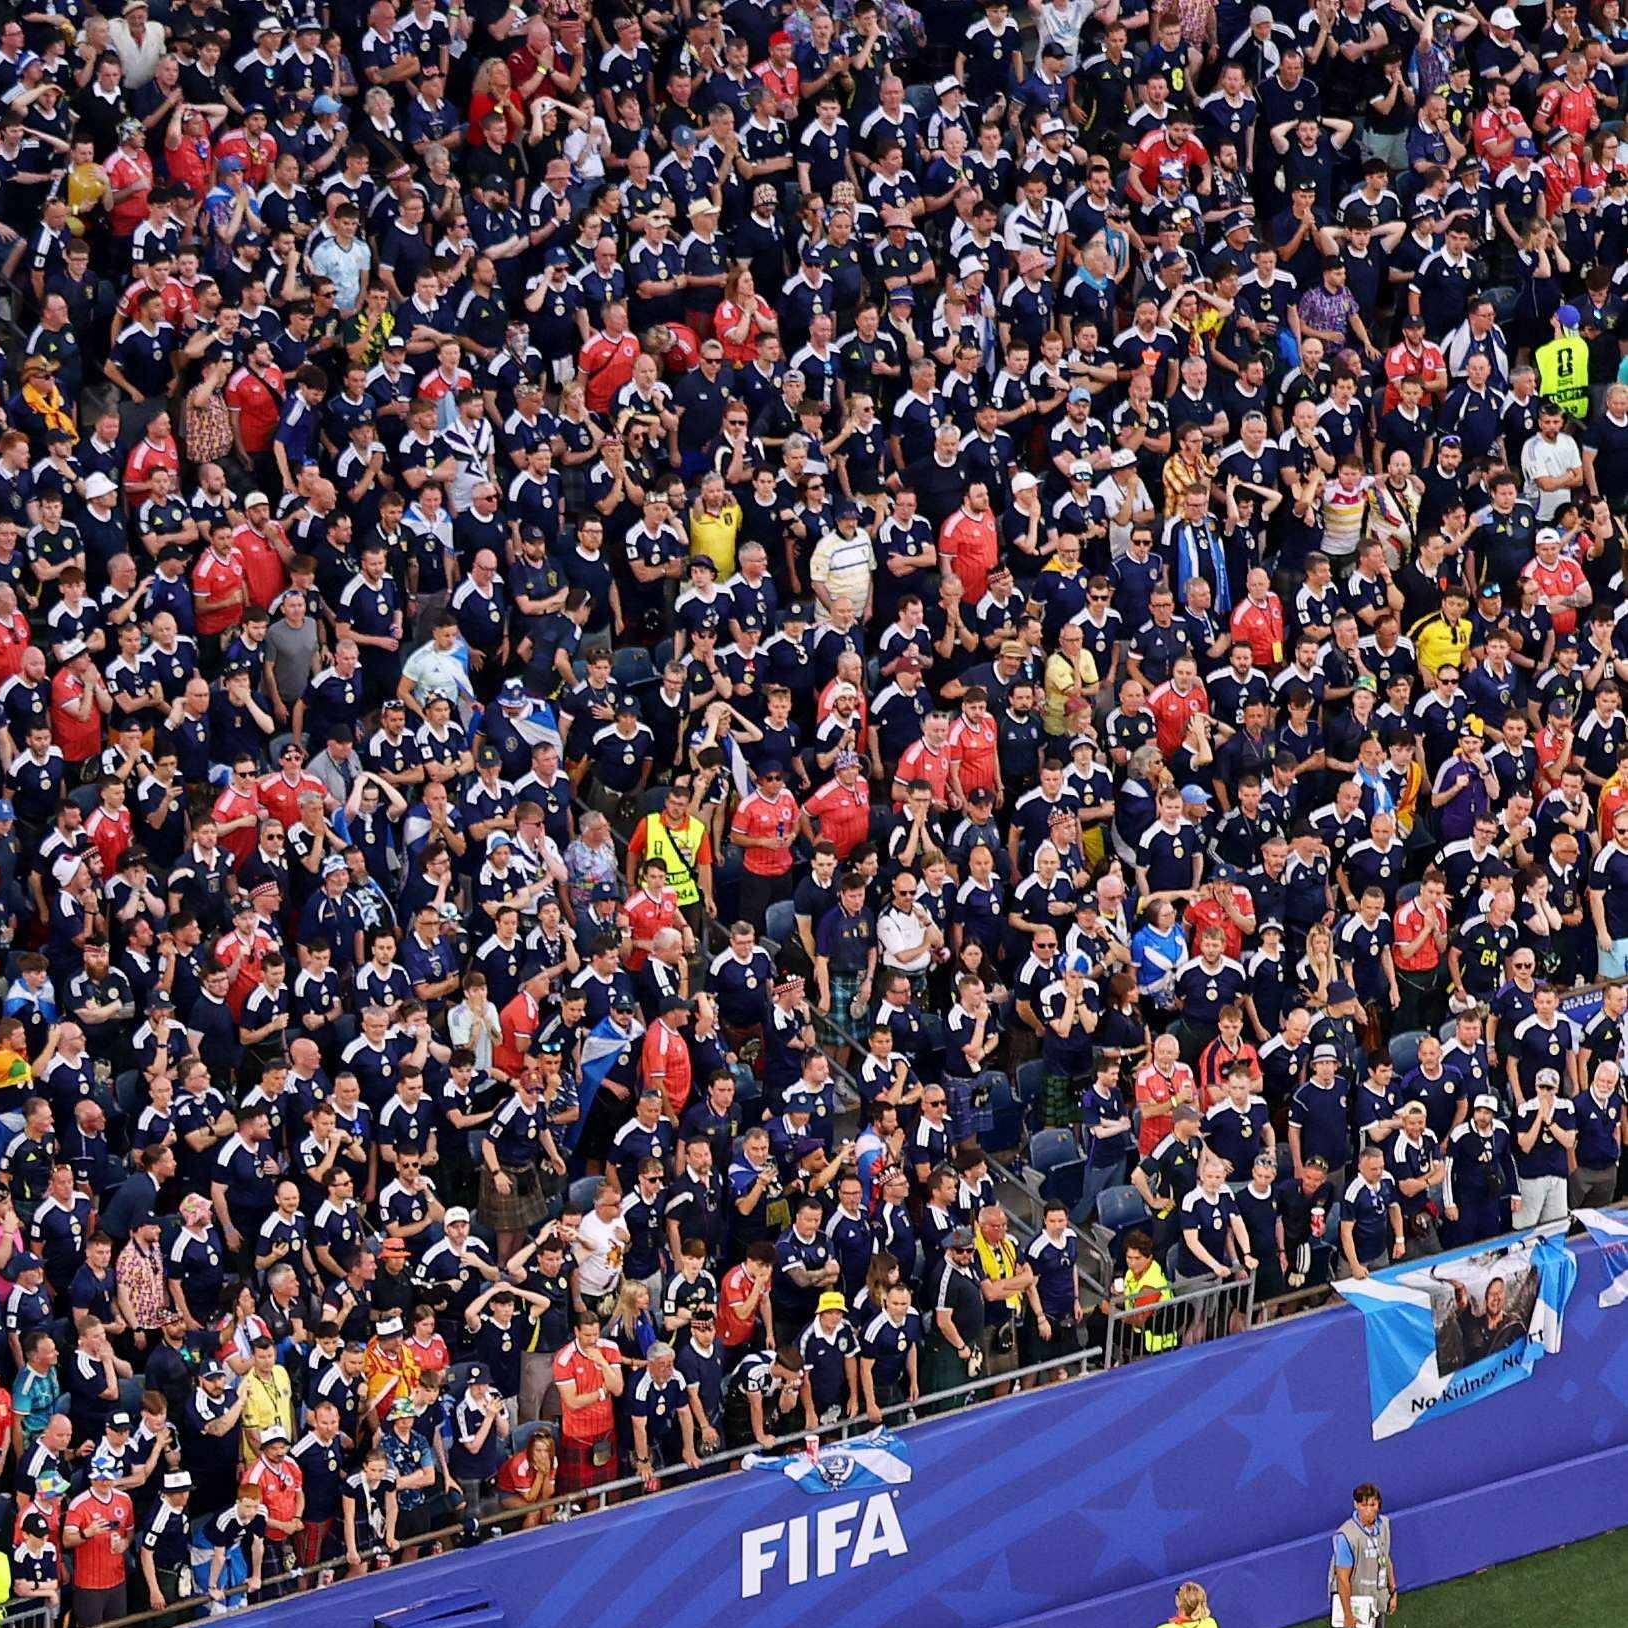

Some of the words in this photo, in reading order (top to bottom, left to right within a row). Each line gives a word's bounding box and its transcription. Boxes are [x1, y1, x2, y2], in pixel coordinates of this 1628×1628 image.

[1480, 948, 1498, 966] 64
[1411, 1396, 1437, 1413] No
[1442, 1369, 1496, 1403] Kidney
[742, 1492, 908, 1598] FIFA
